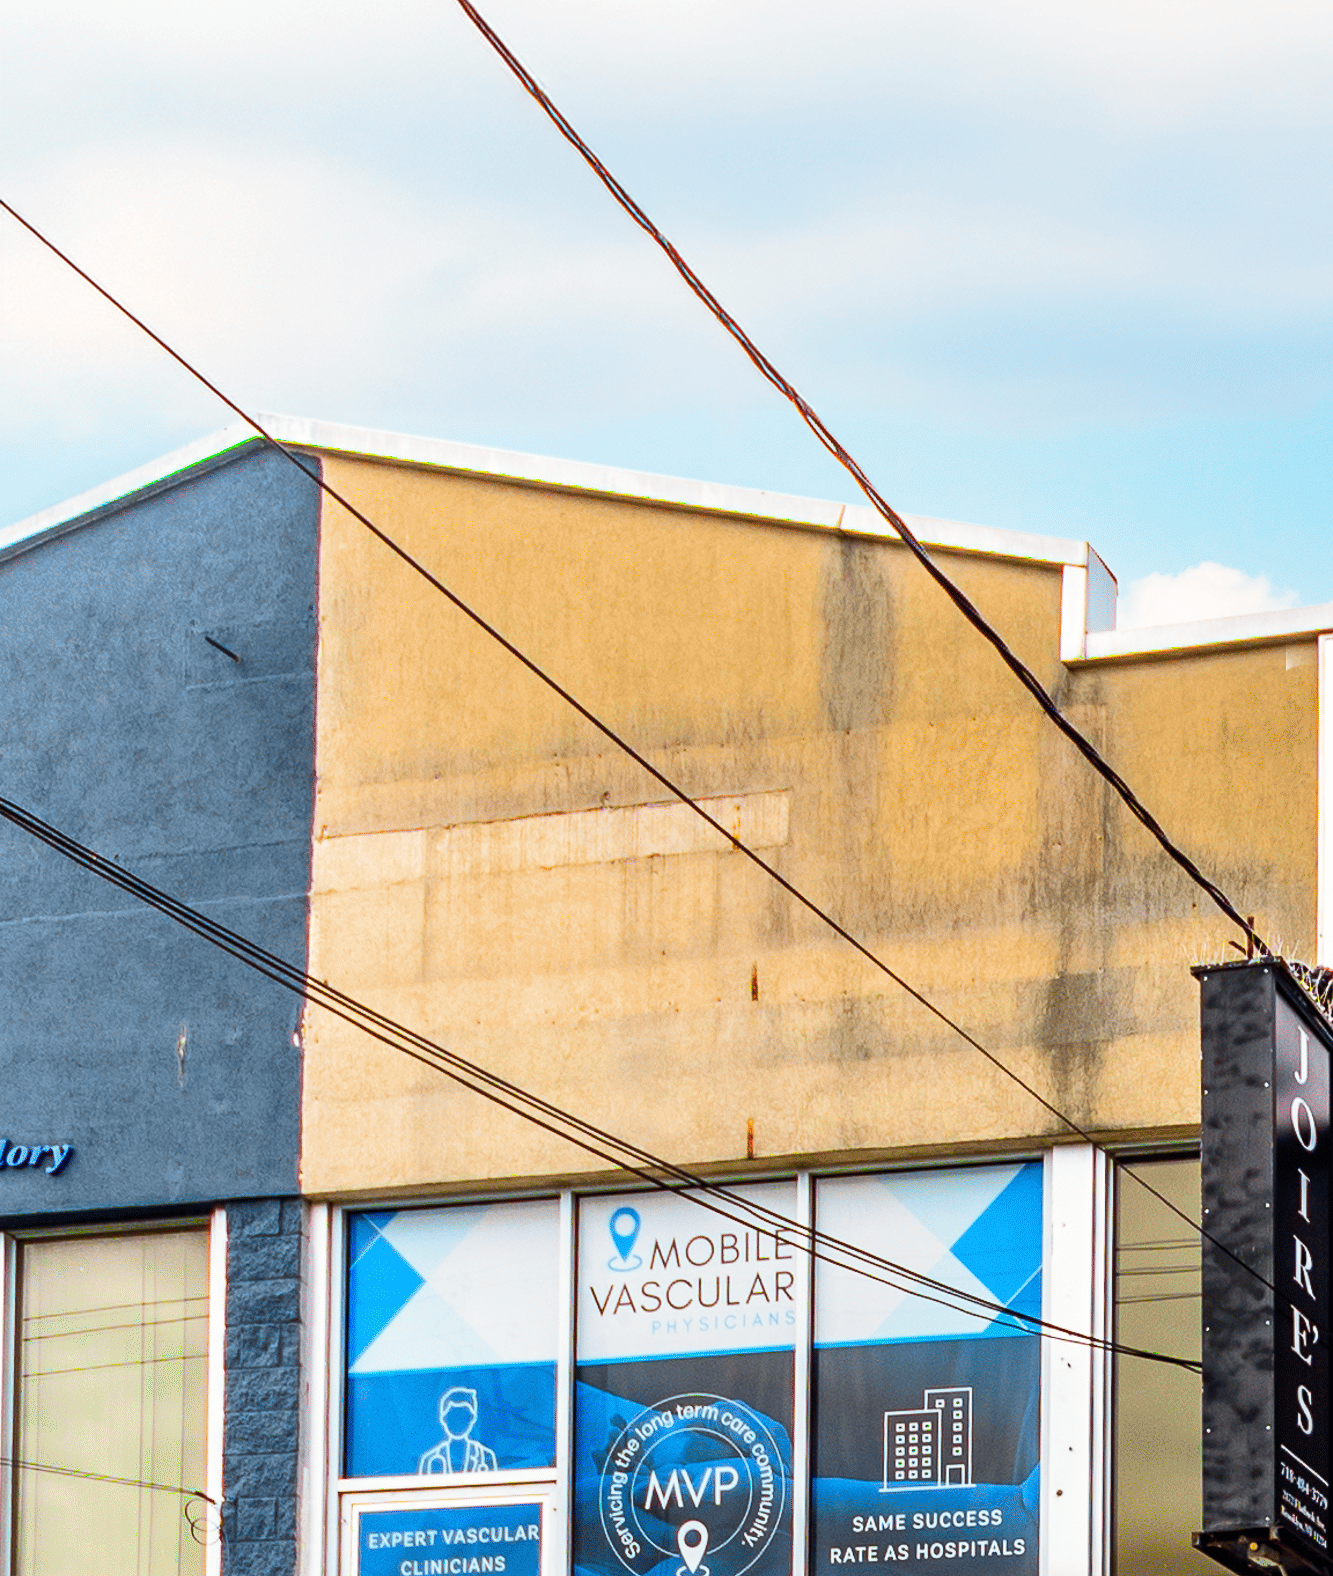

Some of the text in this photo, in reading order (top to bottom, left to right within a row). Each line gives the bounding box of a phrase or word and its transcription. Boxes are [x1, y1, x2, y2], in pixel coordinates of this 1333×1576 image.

[649, 1228, 793, 1270] MOBILE
[589, 1270, 795, 1316] VASCULAR
[651, 1309, 796, 1335] PHYSICIANS
[634, 1410, 675, 1441] long
[675, 1403, 719, 1421] term
[720, 1411, 756, 1444] care
[614, 1437, 640, 1469] the
[644, 1465, 739, 1511] MVP
[607, 1470, 641, 1559] Servicing
[852, 1508, 1004, 1533] SAME SUCCESS
[368, 1523, 541, 1549] EXPERT VASCULAR
[829, 1538, 1027, 1564] RATE AS HOSPITALS
[400, 1555, 507, 1576] CLINICIANS
